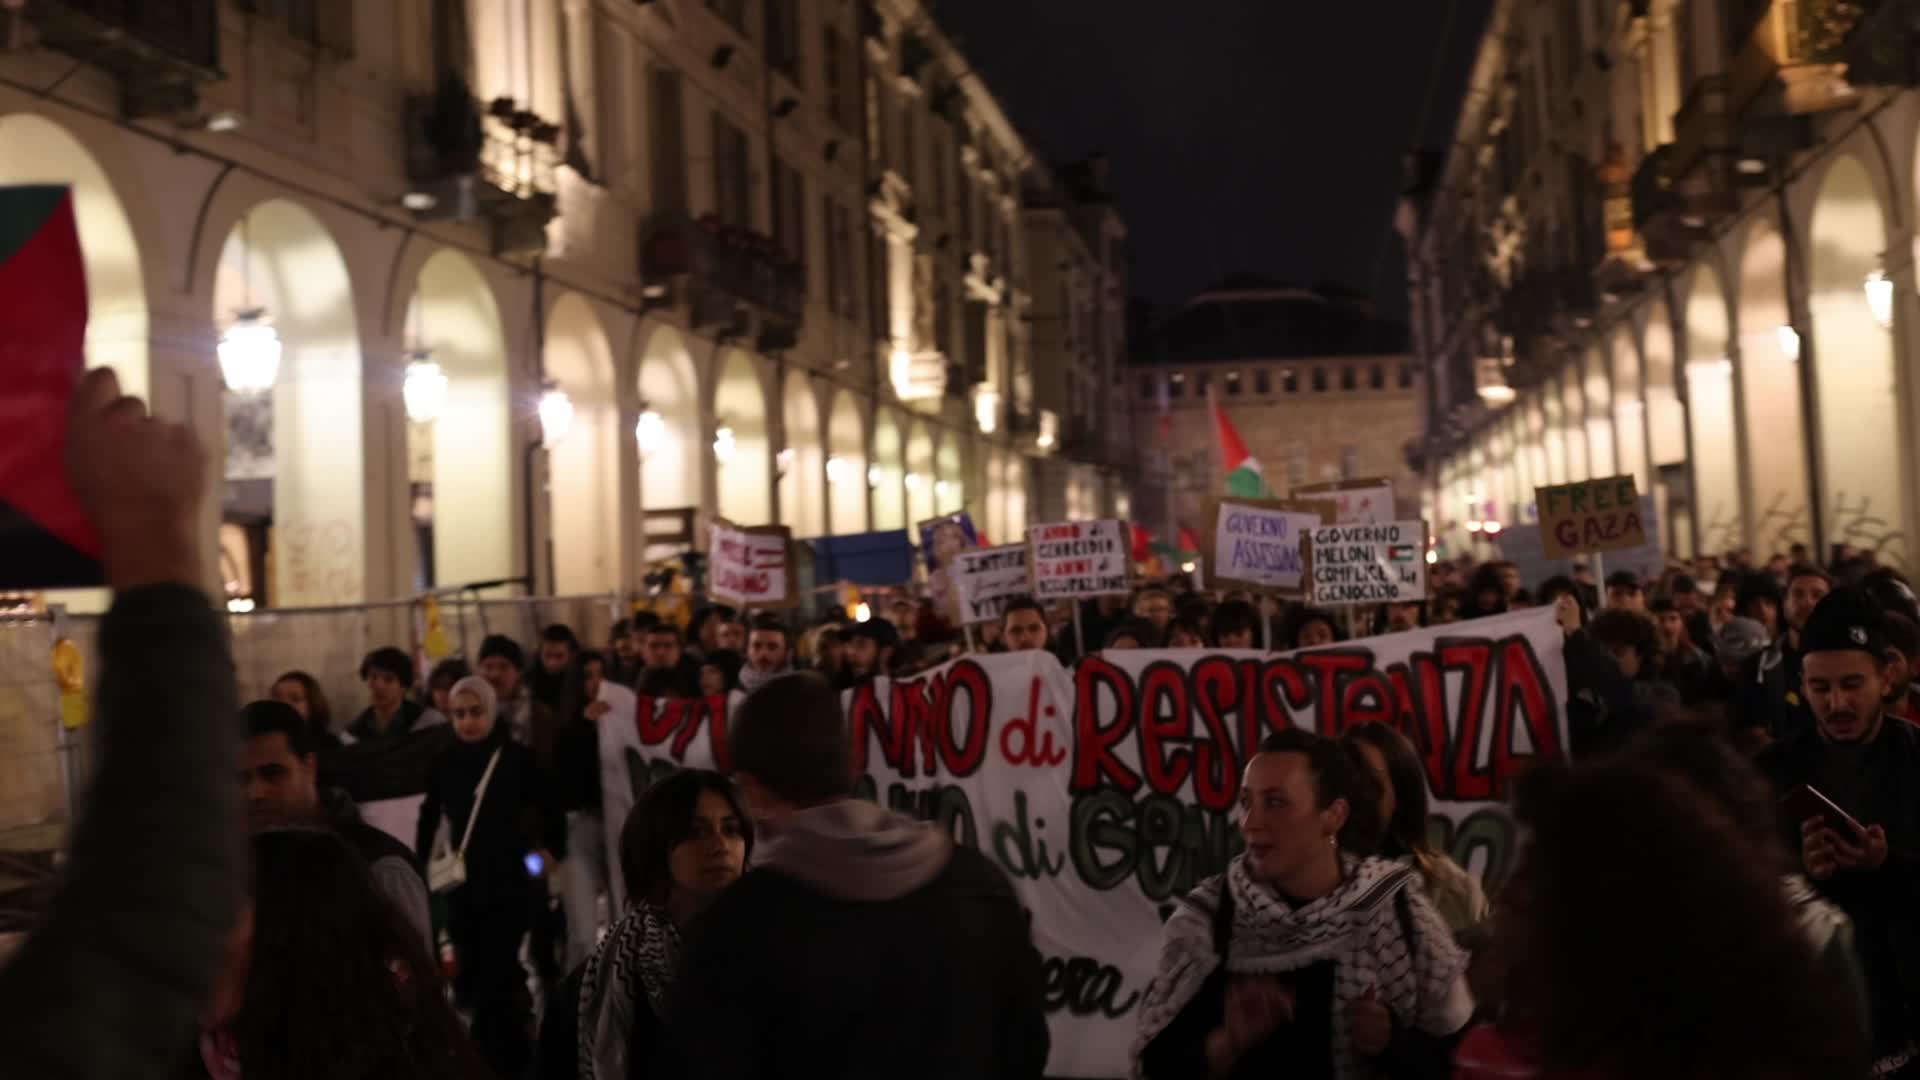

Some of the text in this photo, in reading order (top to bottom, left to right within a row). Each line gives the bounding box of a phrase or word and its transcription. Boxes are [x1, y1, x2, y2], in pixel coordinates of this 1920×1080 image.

[1547, 478, 1635, 515] FREE
[1227, 512, 1287, 539] GOVERNO
[1315, 526, 1400, 545] GOVERNO
[1555, 512, 1641, 548] GAZA
[1038, 540, 1114, 558] GENOCIDIO
[1316, 545, 1376, 565] MELONI
[1318, 583, 1399, 602] GENOCIDIO
[849, 660, 993, 778] NNO
[1000, 677, 1066, 768] di
[994, 789, 1066, 880] di
